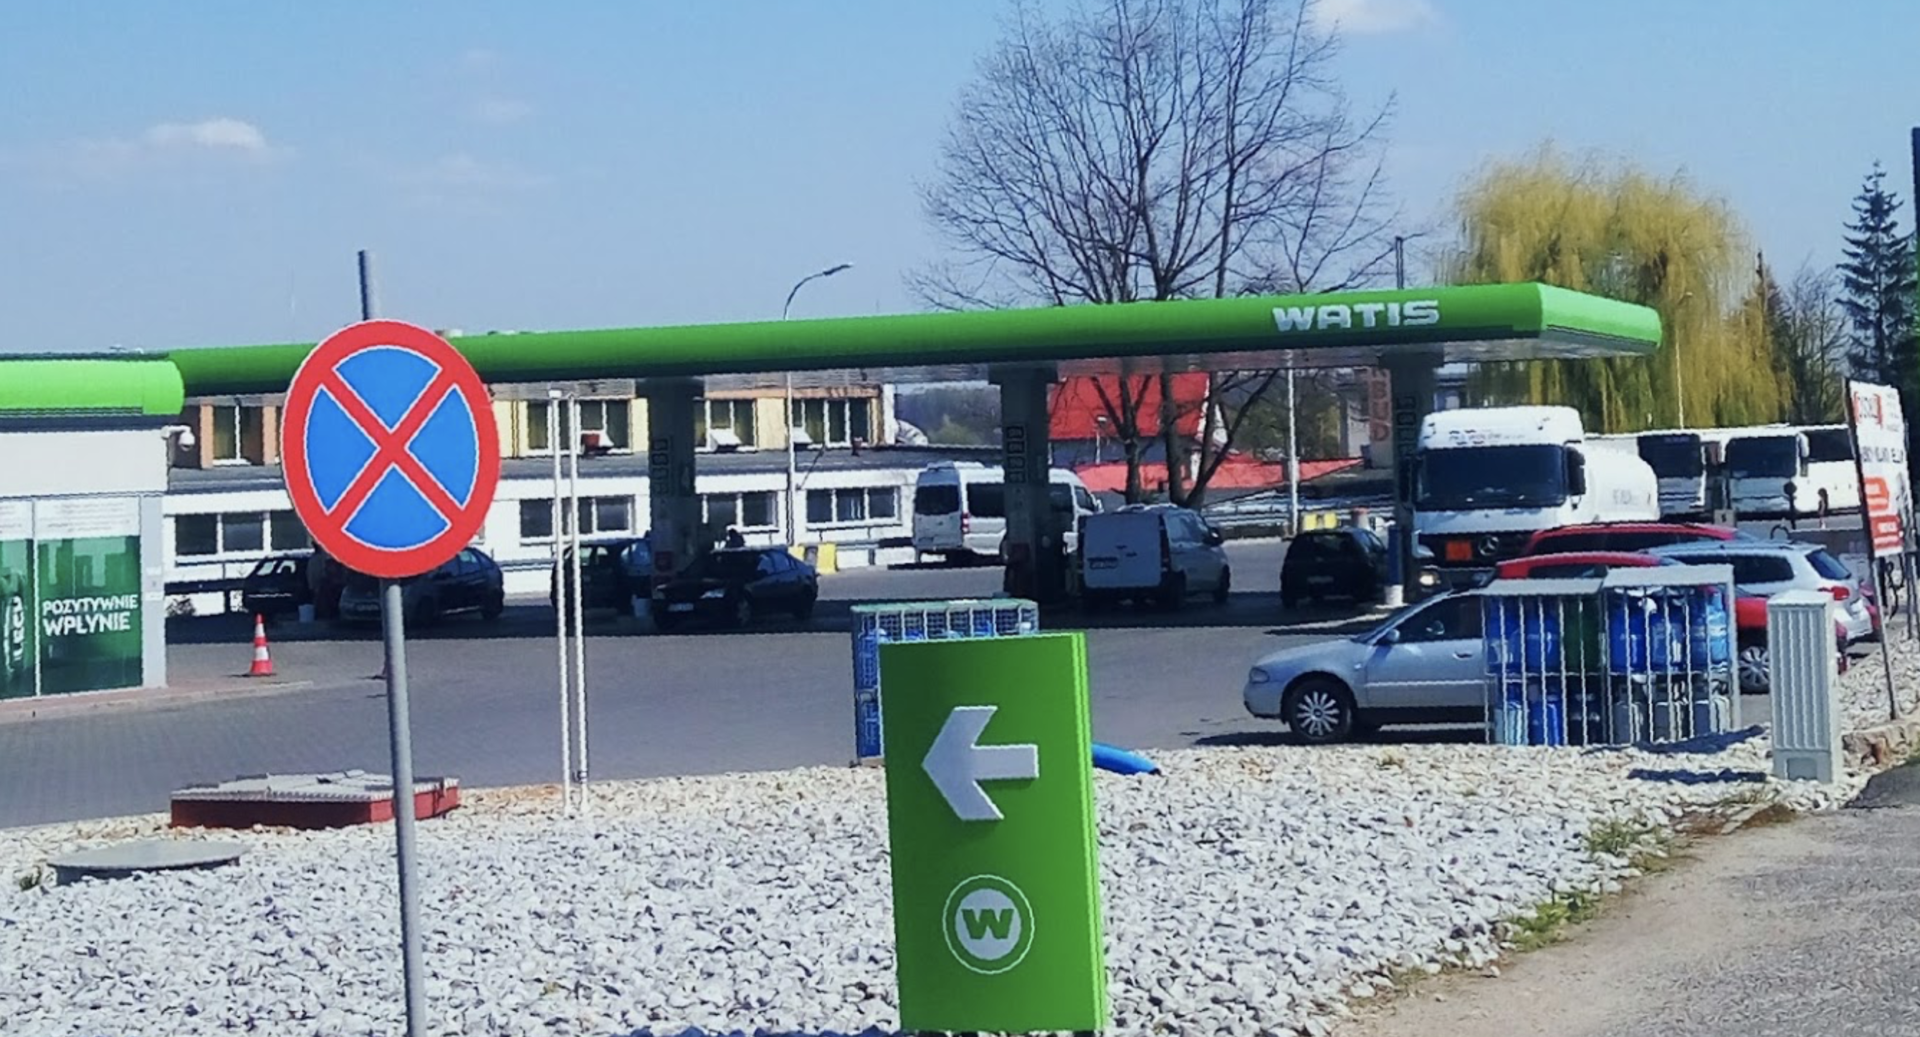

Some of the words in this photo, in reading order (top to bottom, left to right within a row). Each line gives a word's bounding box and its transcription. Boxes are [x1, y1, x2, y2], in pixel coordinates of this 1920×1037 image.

[1272, 300, 1440, 332] WATIS
[42, 594, 139, 616] POZYTYWNIE
[42, 611, 131, 637] WPŁYNIE
[961, 908, 1014, 940] W
